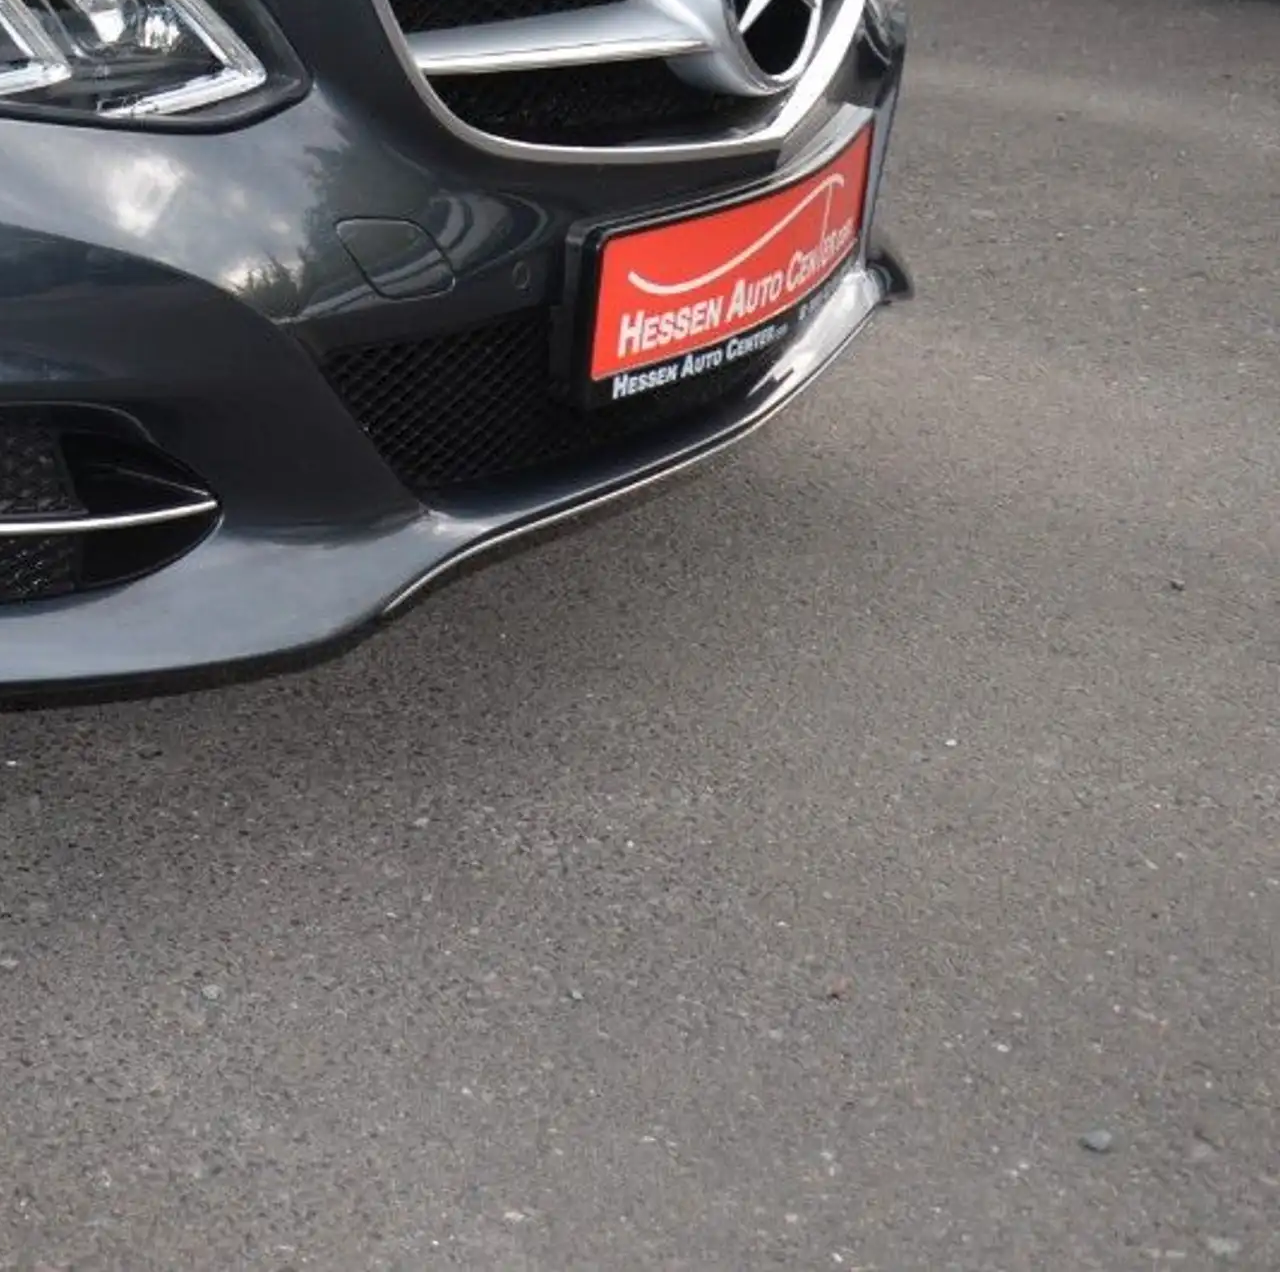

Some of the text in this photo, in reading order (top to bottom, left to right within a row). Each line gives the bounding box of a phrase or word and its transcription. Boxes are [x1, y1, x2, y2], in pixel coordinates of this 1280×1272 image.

[617, 294, 722, 358] HESSEN
[724, 270, 783, 322] AUTO
[612, 362, 679, 400] HESSEN
[680, 349, 722, 378] AUTO
